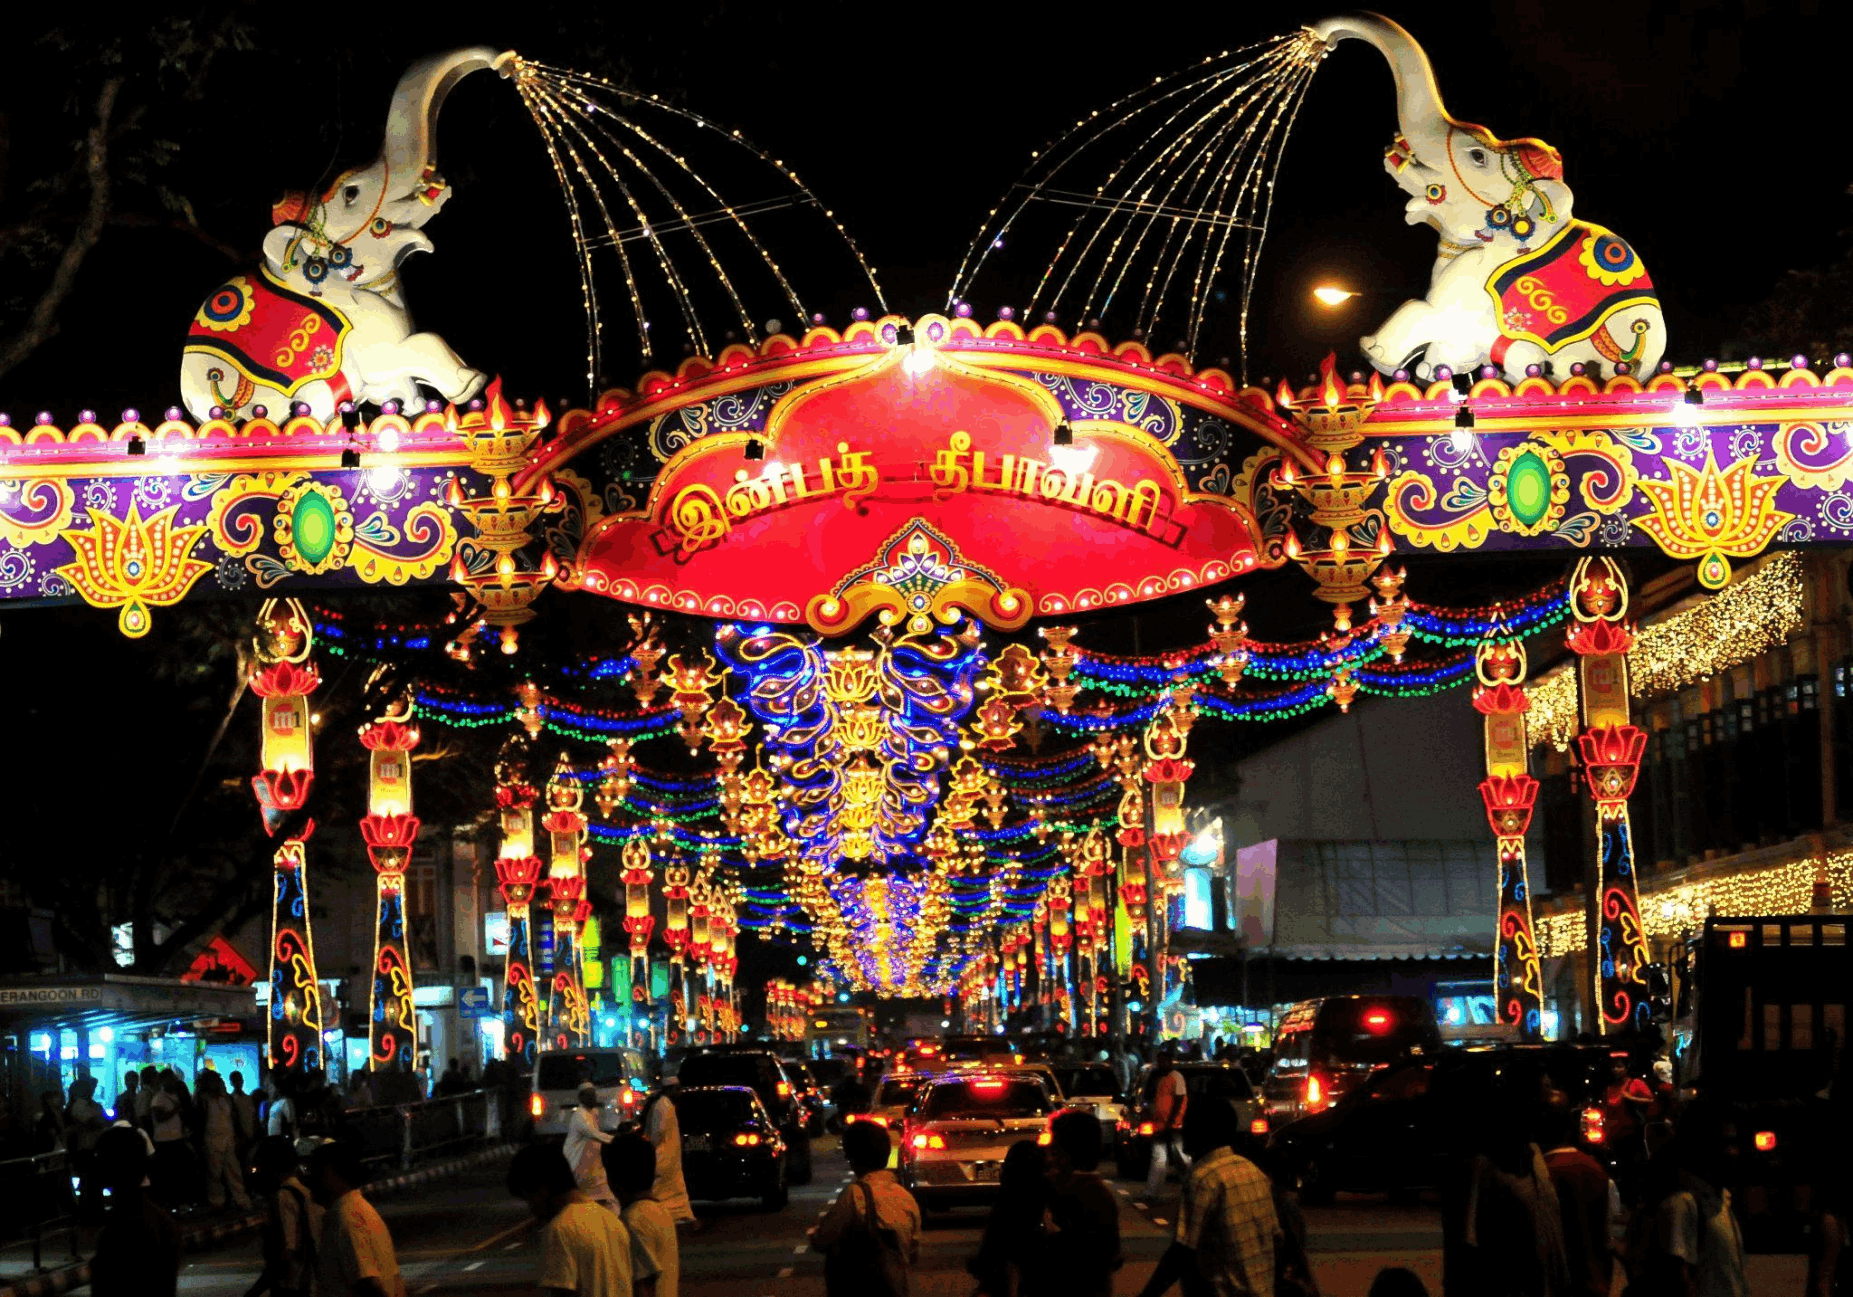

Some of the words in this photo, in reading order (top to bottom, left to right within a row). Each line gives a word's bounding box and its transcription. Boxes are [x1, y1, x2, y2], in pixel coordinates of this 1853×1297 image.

[673, 442, 879, 552] இன்பத்
[929, 431, 1161, 531] தீபாவளி
[81, 987, 99, 999] RD
